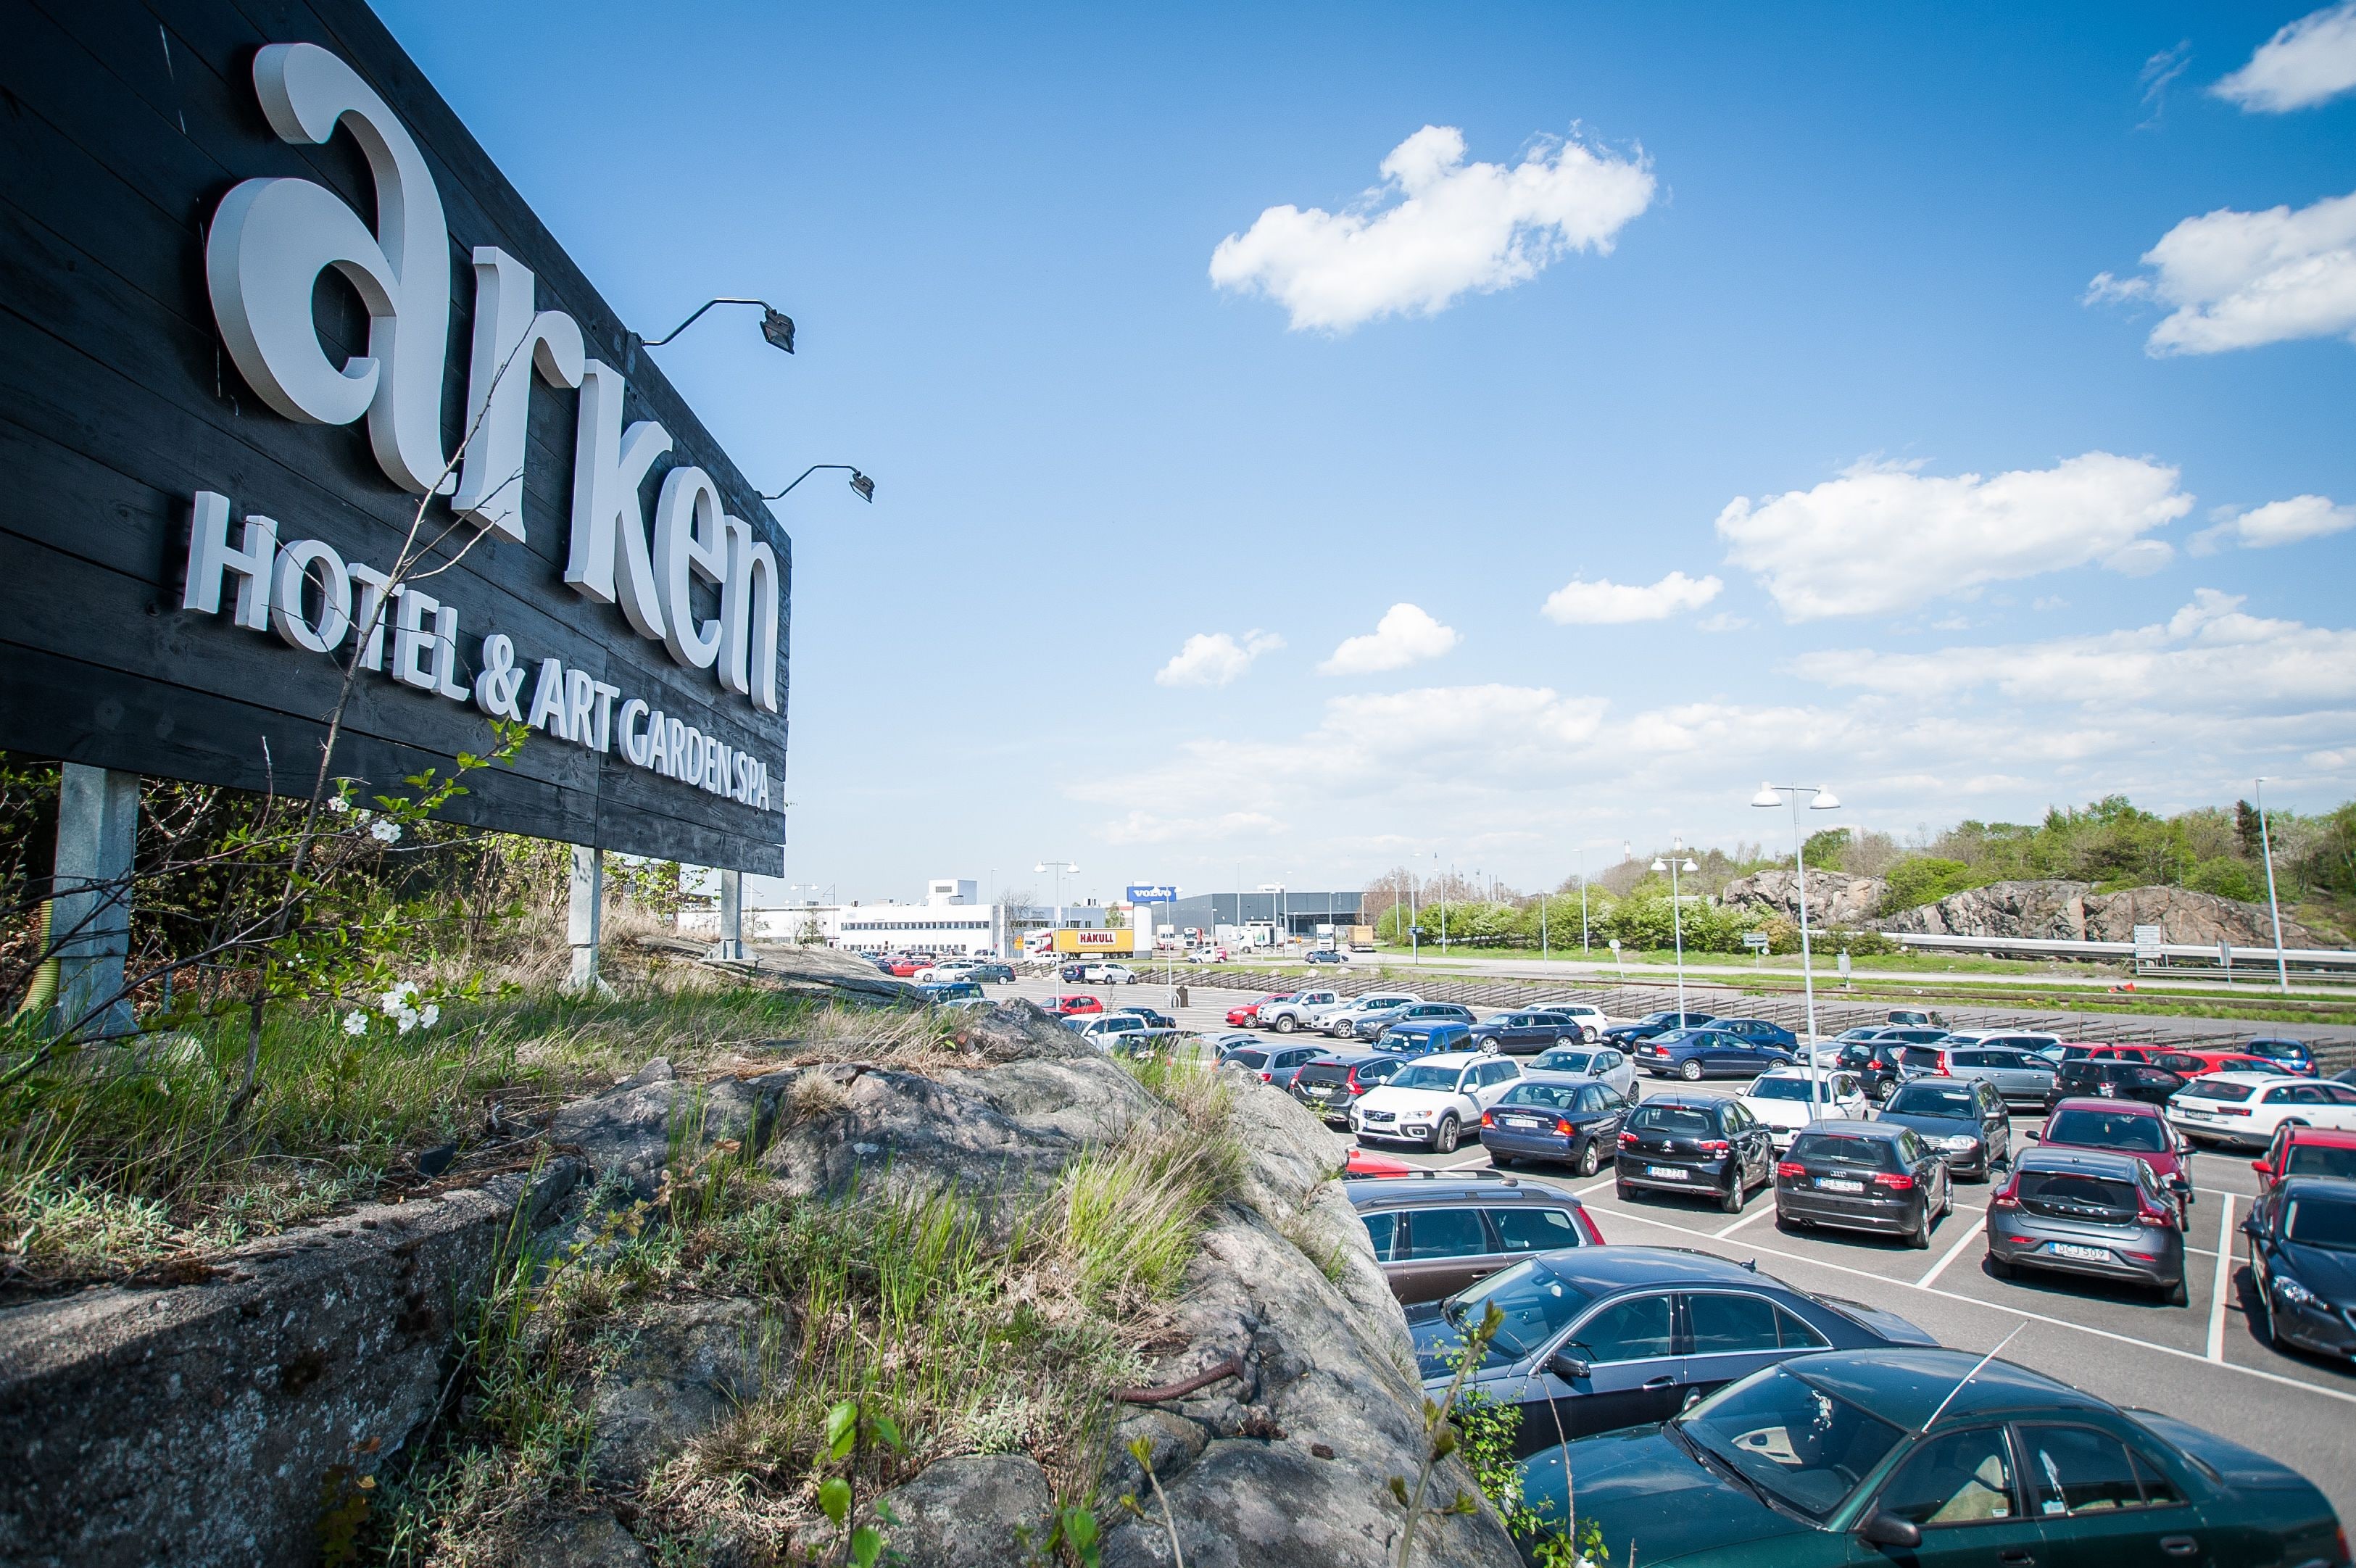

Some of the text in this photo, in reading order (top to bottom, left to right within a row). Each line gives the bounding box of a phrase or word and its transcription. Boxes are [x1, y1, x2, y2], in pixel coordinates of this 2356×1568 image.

[207, 42, 779, 713] arken
[183, 490, 770, 811] HOTEL & ART GARDEN SPA
[1079, 932, 1114, 943] HÅKULL
[2082, 1246, 2104, 1257] 509
